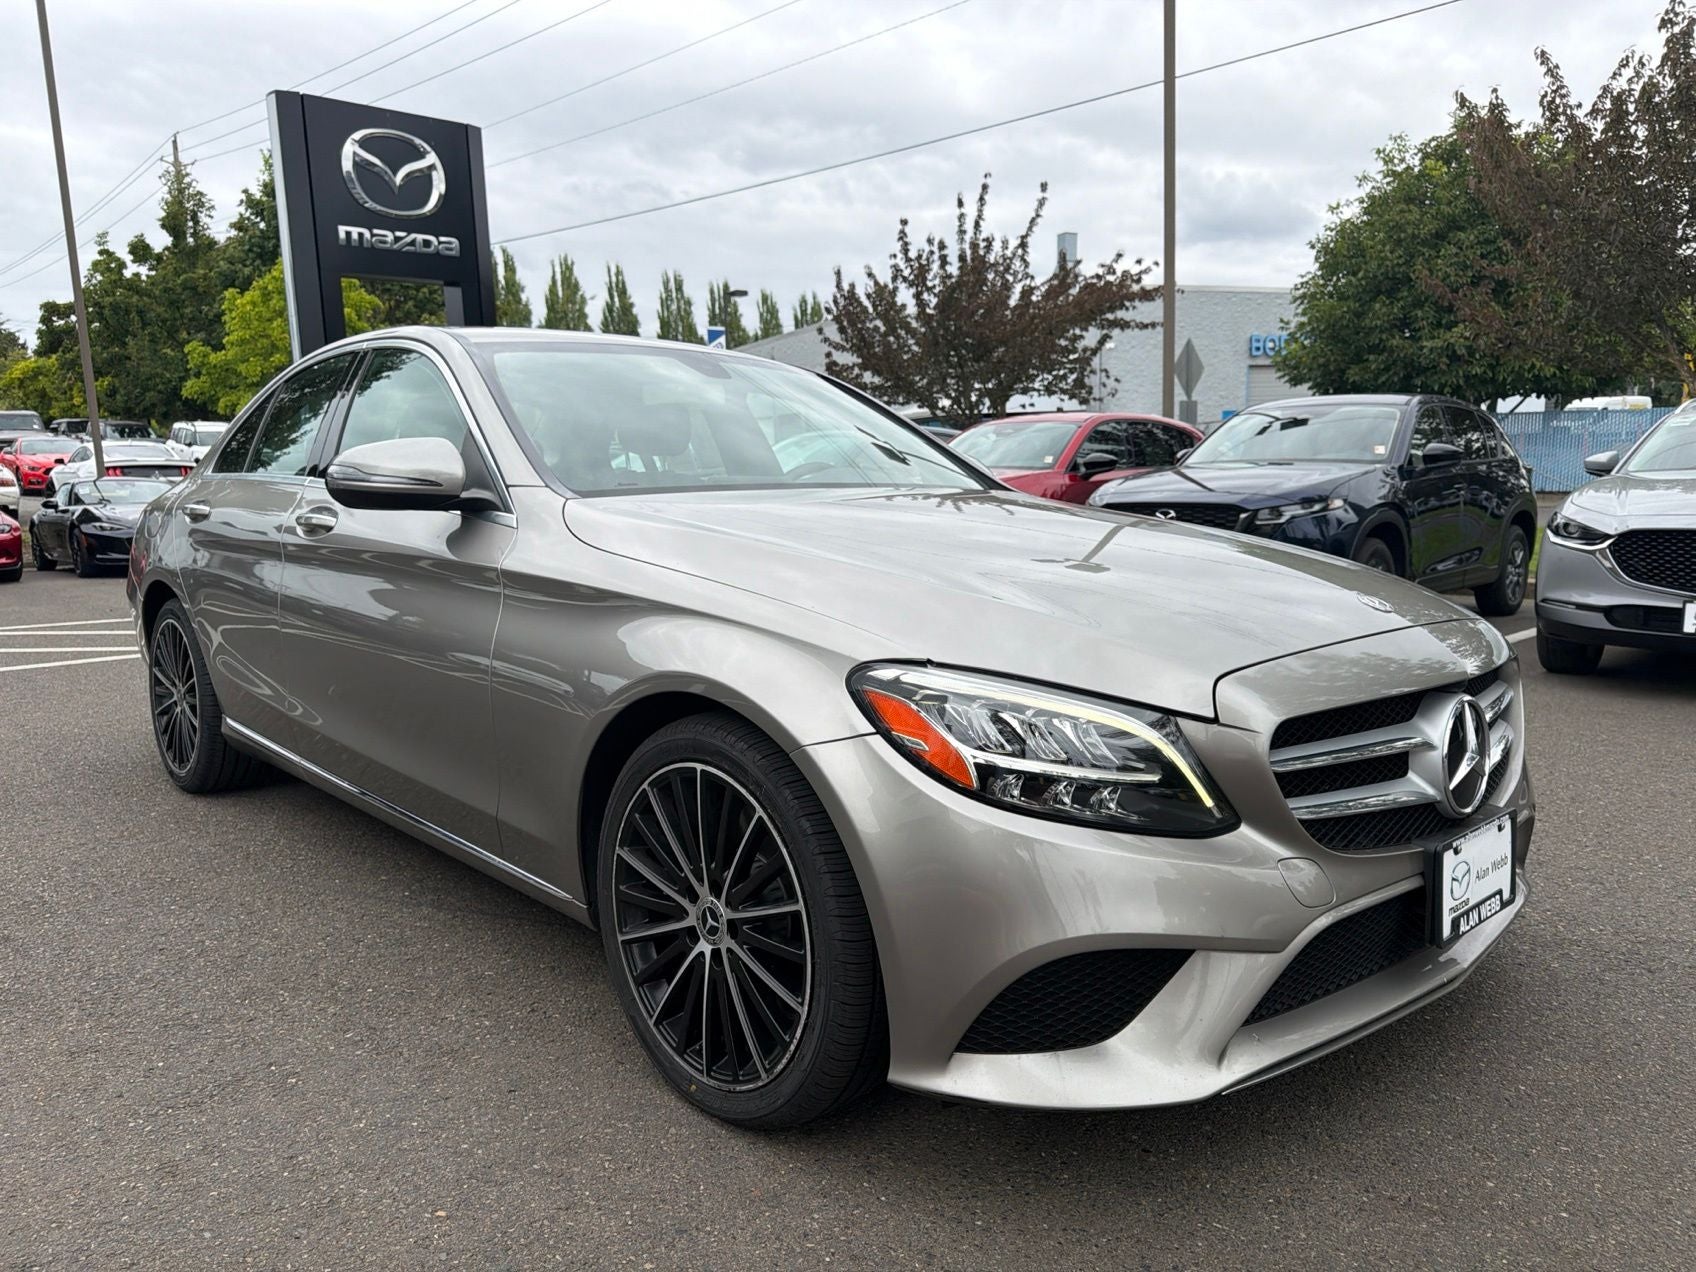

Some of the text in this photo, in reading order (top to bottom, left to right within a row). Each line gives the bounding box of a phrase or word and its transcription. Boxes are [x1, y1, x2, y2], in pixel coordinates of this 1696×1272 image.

[1475, 852, 1509, 883] Alan Webb
[1459, 894, 1501, 935] ALAN WEBB
